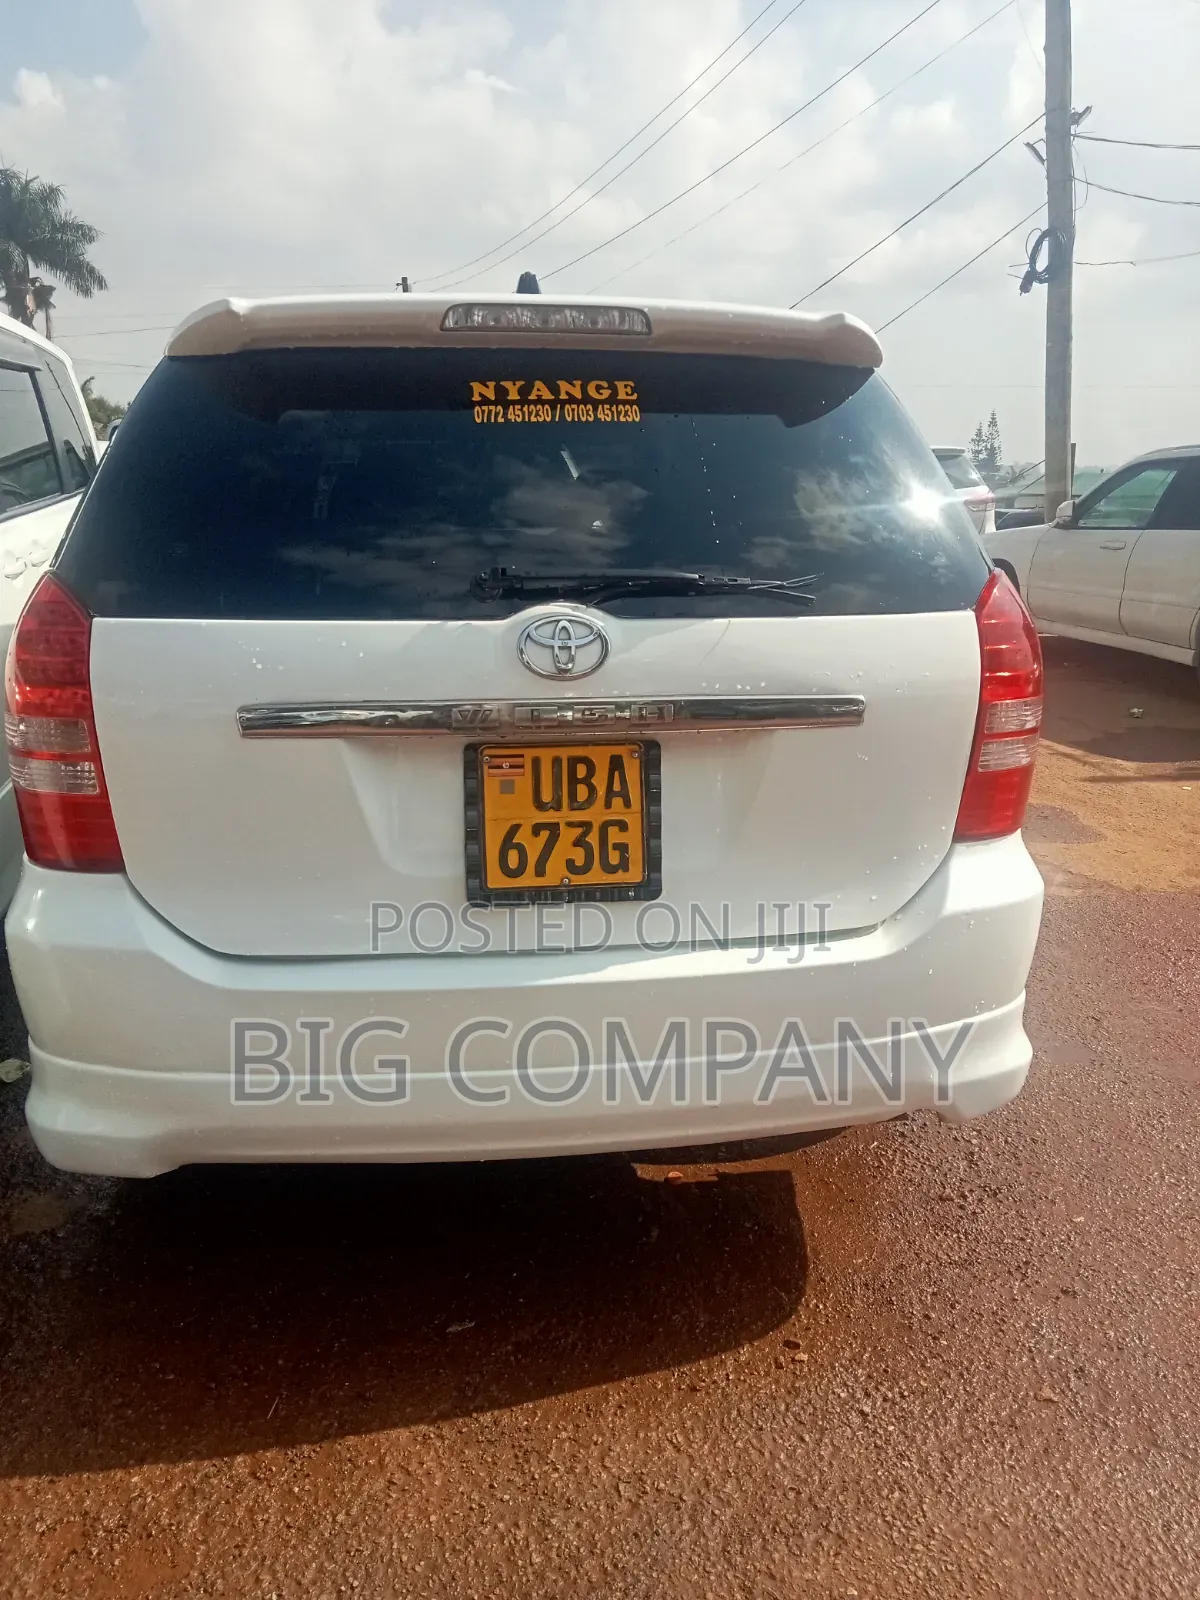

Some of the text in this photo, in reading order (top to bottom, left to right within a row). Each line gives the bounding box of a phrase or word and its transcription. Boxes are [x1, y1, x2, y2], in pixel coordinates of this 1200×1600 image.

[469, 380, 638, 401] NYANGE
[474, 405, 505, 424] 0772
[507, 404, 551, 422] 451230
[564, 404, 594, 422] 0703
[597, 404, 641, 422] 451230
[531, 754, 632, 812] UBA
[498, 818, 630, 879] 673G
